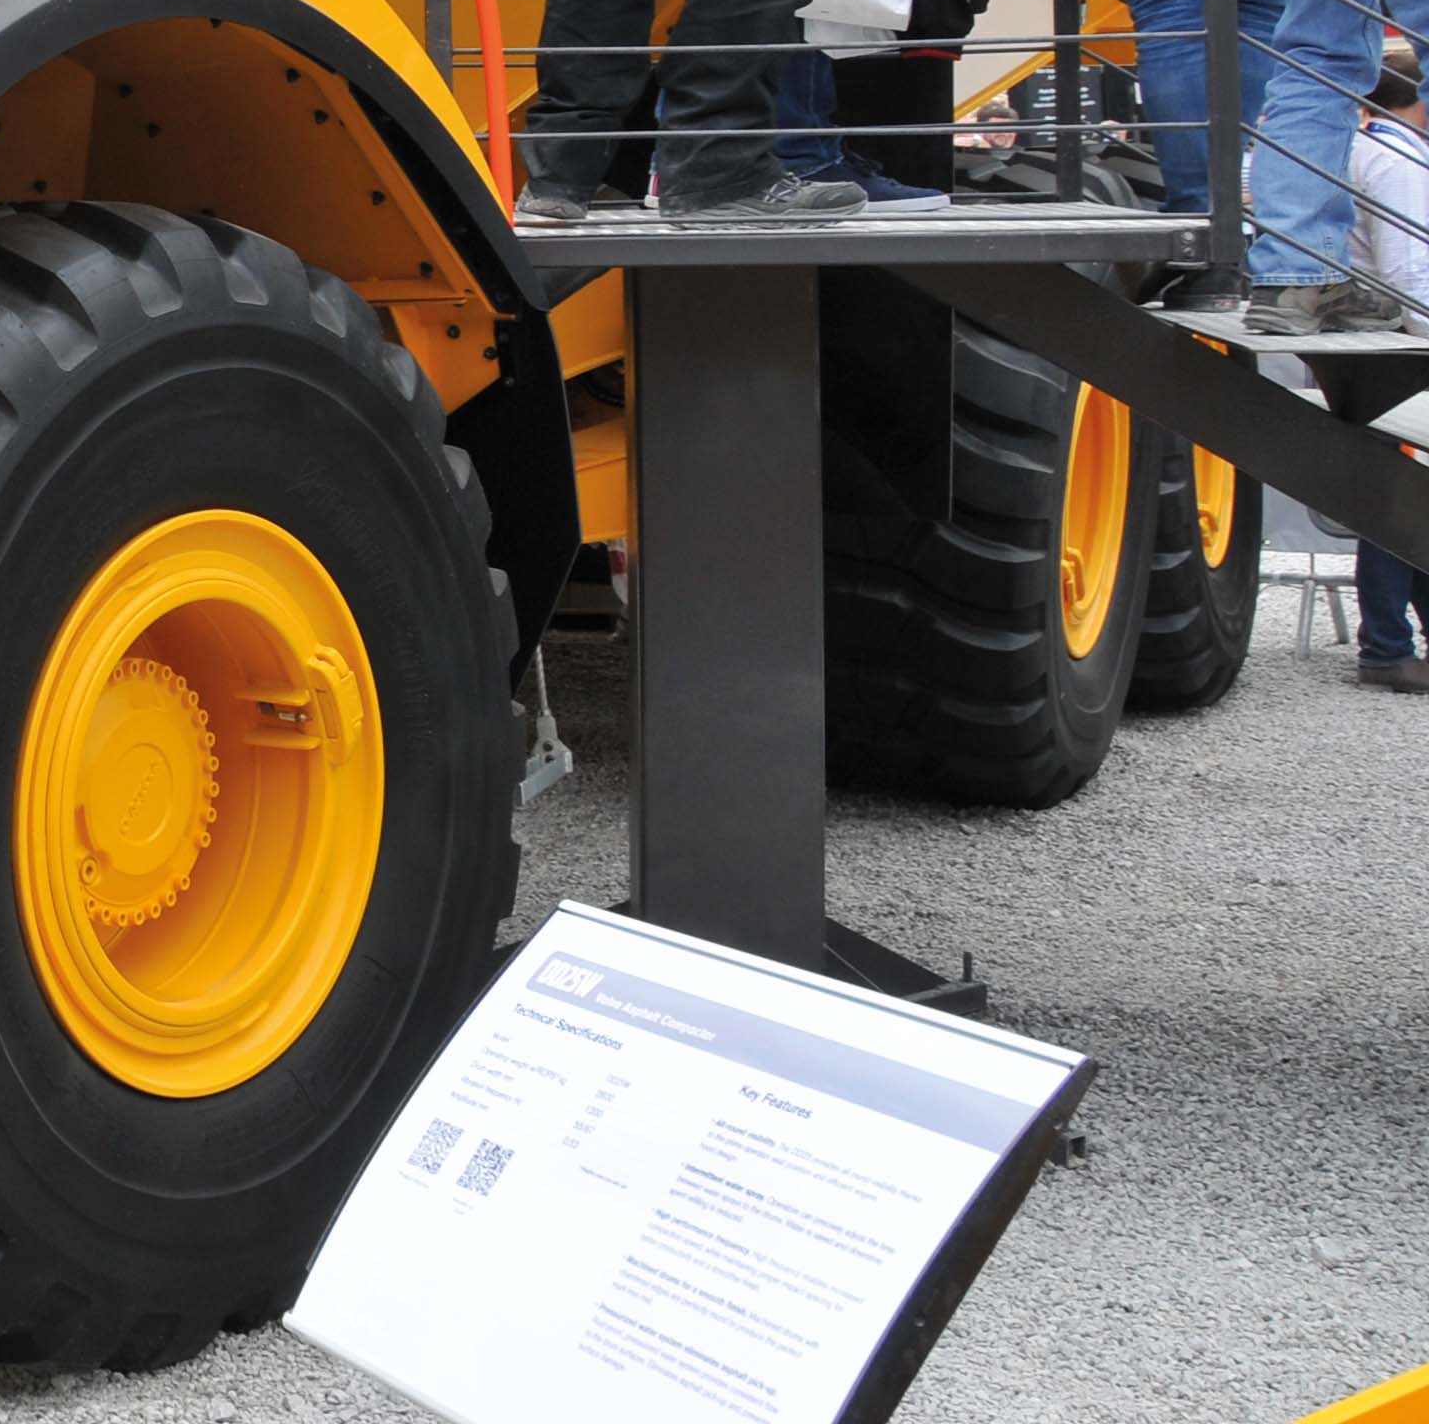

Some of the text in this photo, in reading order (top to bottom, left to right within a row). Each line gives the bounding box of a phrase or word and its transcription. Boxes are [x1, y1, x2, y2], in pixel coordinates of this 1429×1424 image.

[515, 1003, 623, 1050] Technical Specifications
[620, 1001, 661, 1024] Asphalt
[660, 1014, 717, 1041] Compactor
[738, 1085, 812, 1119] Key Features
